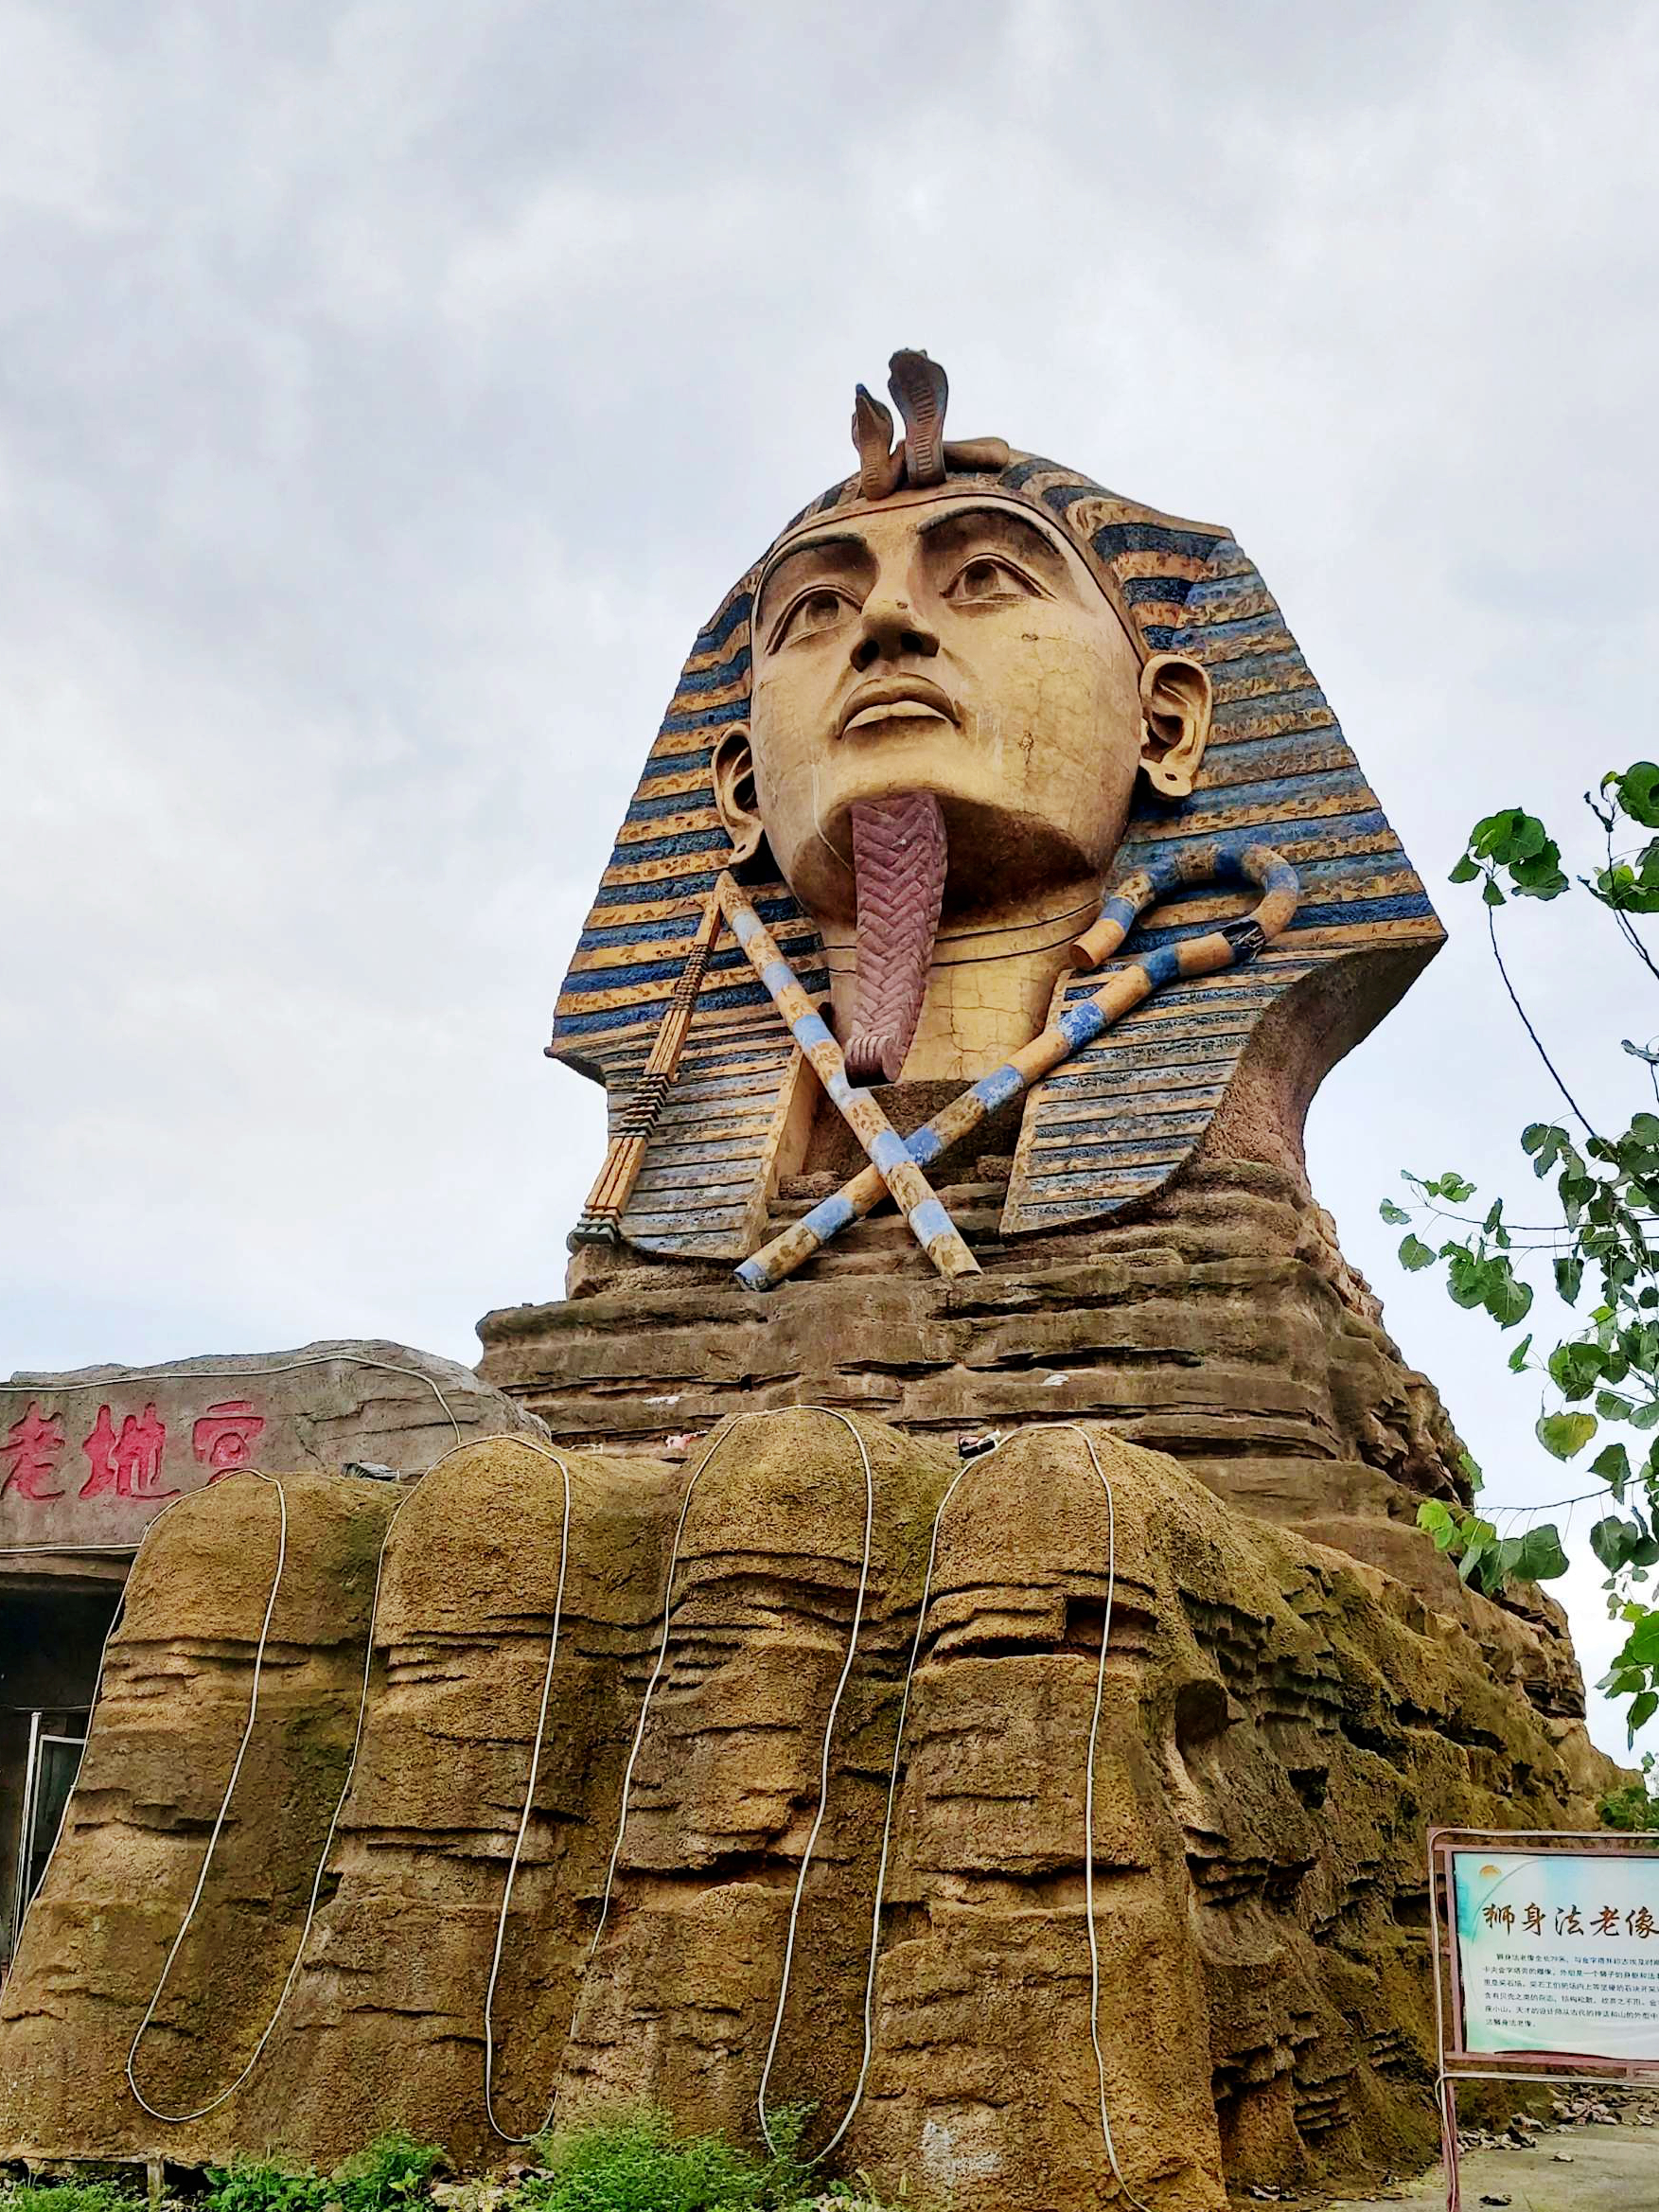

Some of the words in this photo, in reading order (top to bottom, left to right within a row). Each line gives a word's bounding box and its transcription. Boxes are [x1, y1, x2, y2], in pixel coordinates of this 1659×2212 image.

[1482, 1902, 1659, 1938] 狮身法老像
